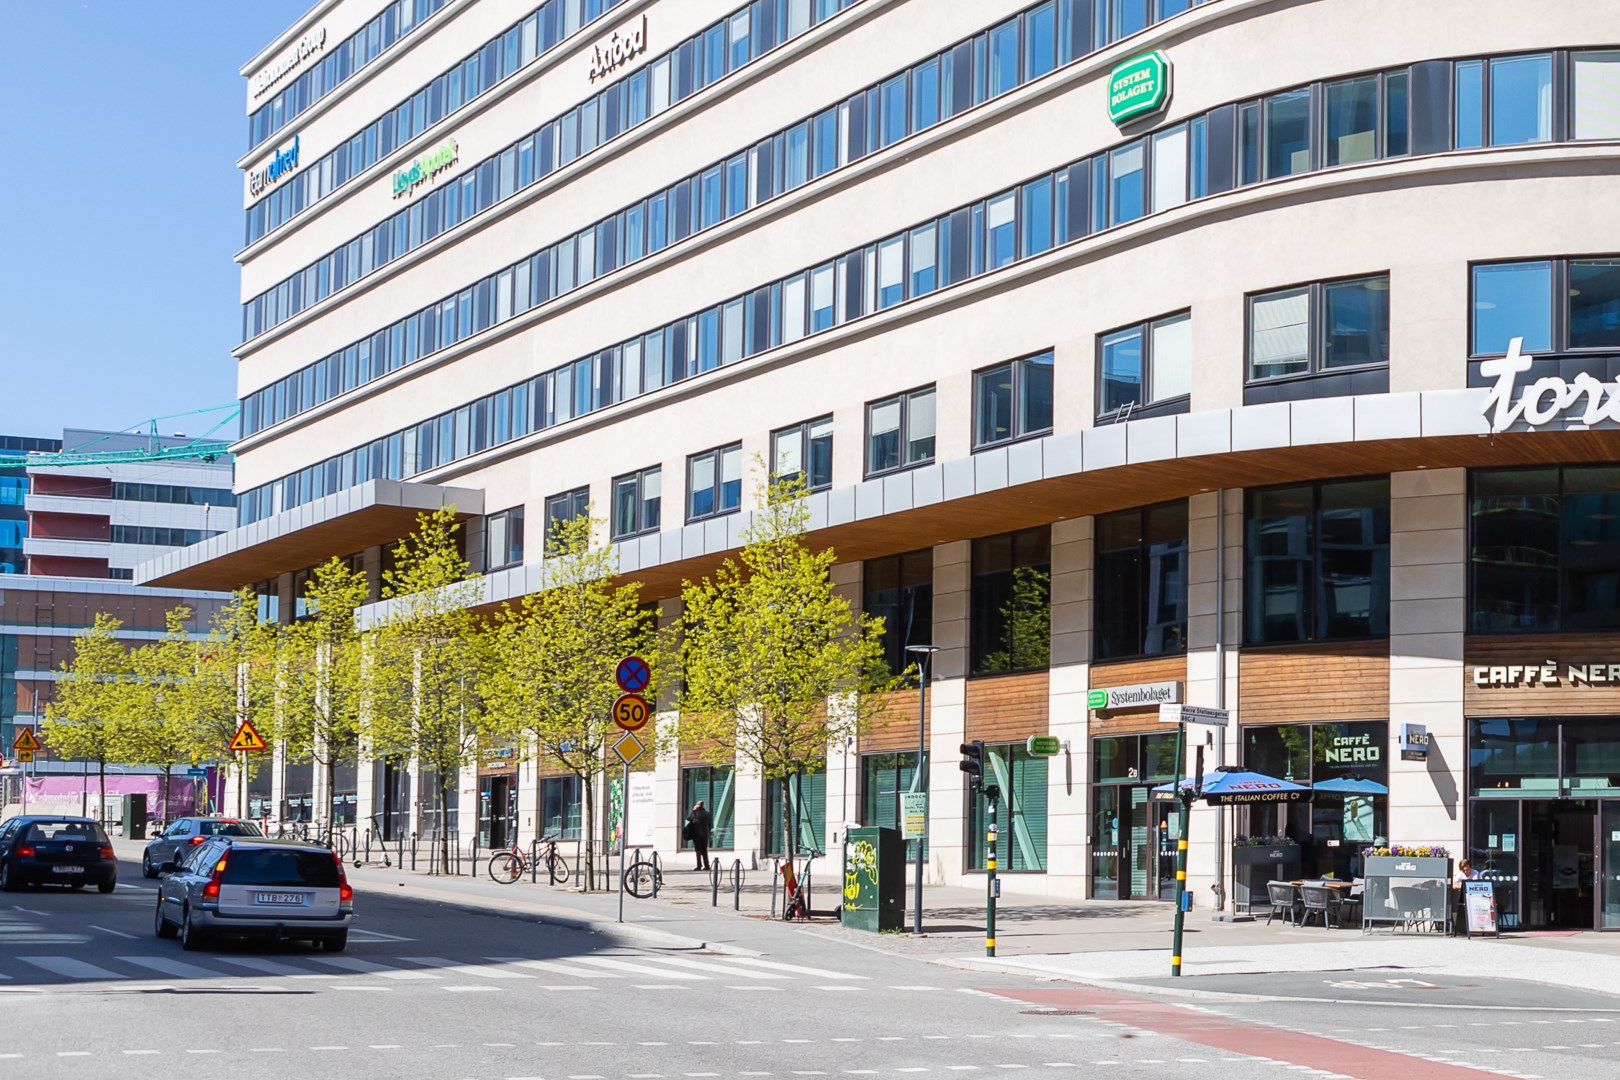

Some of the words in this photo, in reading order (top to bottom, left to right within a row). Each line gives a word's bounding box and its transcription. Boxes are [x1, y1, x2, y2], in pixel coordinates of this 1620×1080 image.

[1112, 67, 1152, 93] SYSTEM
[1111, 79, 1155, 107] BOLAGET
[1473, 659, 1558, 684] CAFFÈ
[1111, 686, 1171, 706] Systembolaget
[619, 703, 644, 722] 50
[1333, 733, 1370, 746] CAFFÈ
[1409, 734, 1429, 745] NERO
[1325, 747, 1380, 763] NERO
[1228, 783, 1282, 791] NERO
[1220, 794, 1233, 802] THE
[1234, 794, 1261, 802] ITALIAN
[1261, 792, 1288, 801] COFFEE
[283, 893, 301, 902] 276
